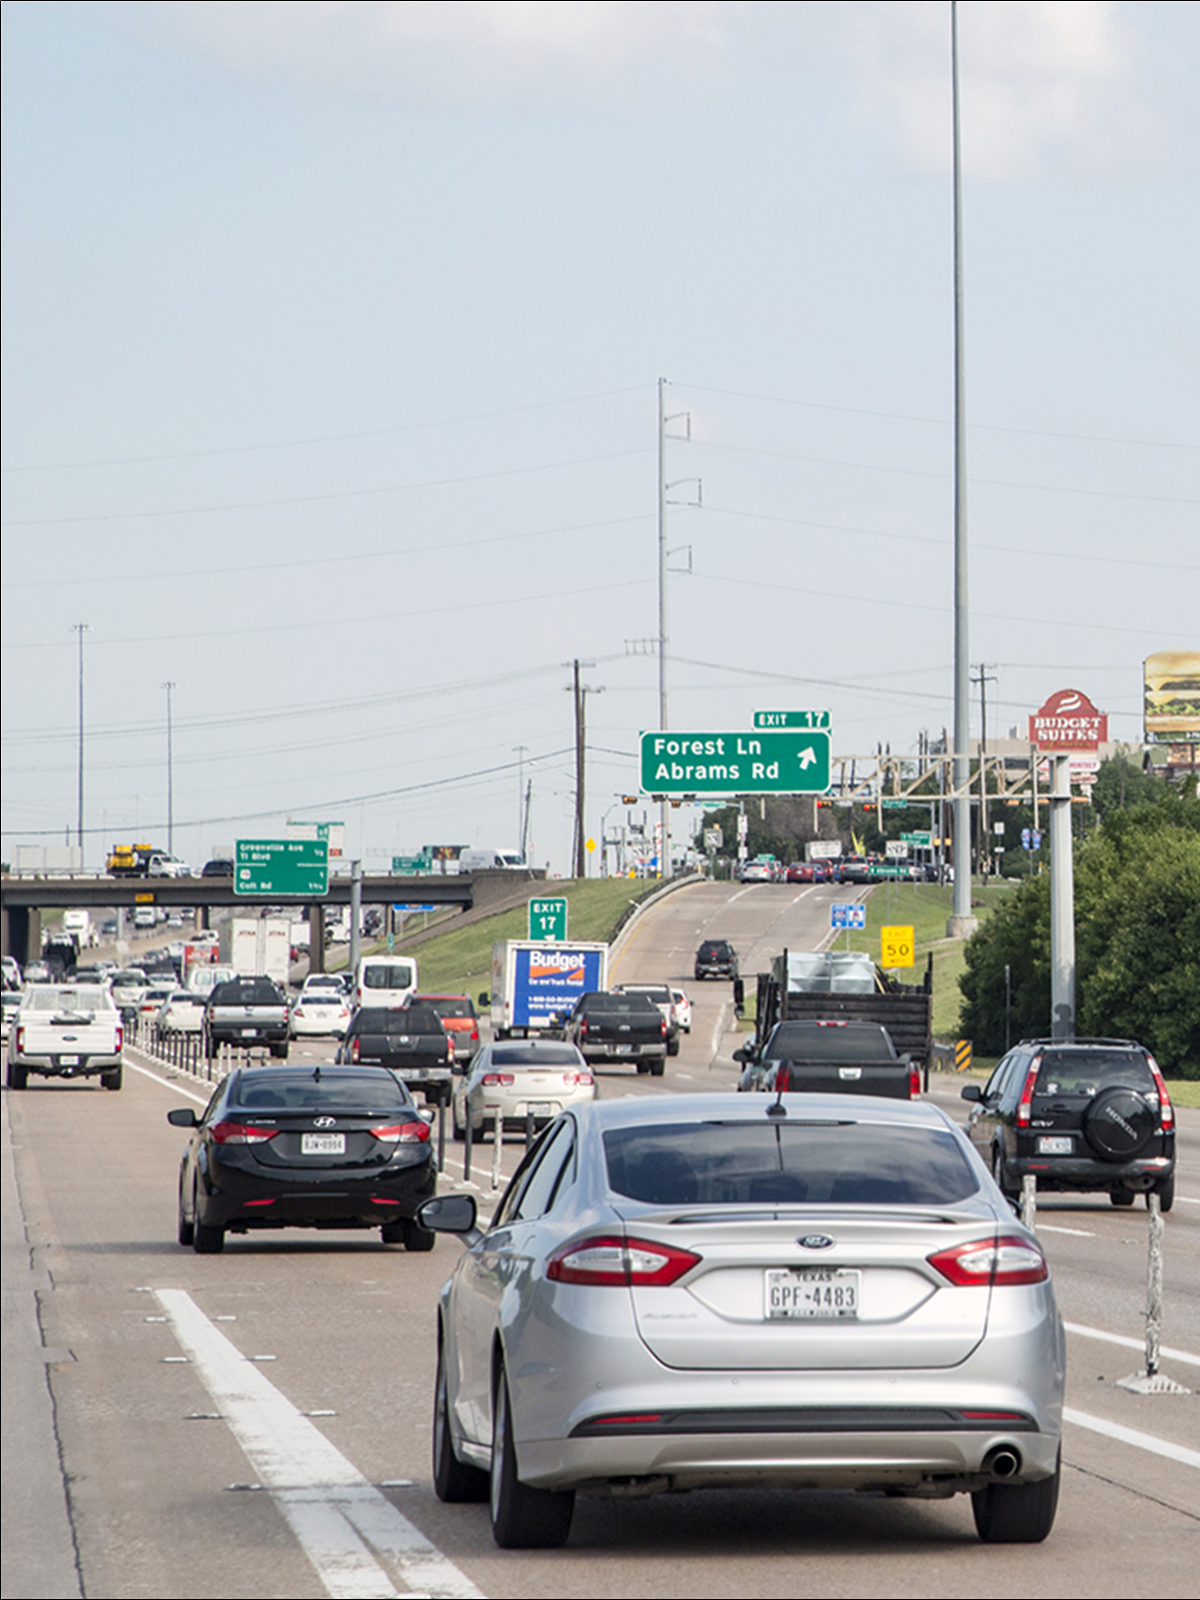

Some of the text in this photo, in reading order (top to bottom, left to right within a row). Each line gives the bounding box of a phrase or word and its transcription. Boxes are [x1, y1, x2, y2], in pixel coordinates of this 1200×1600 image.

[758, 712, 824, 728] EXIT 17
[1034, 717, 1101, 729] BUDGET
[1038, 729, 1098, 741] SUITES
[654, 738, 761, 755] Forest Ln
[655, 761, 779, 780] Abrams Rd
[240, 843, 304, 852] Greenville Ave
[252, 853, 271, 861] Blvd
[533, 903, 563, 913] EXIT
[539, 917, 556, 930] 17
[887, 944, 909, 956] 50
[530, 950, 586, 971] Budget
[528, 978, 538, 986] Car
[551, 978, 565, 986] Truck
[1105, 1106, 1138, 1140] HONDA
[795, 1273, 832, 1282] TEXAS
